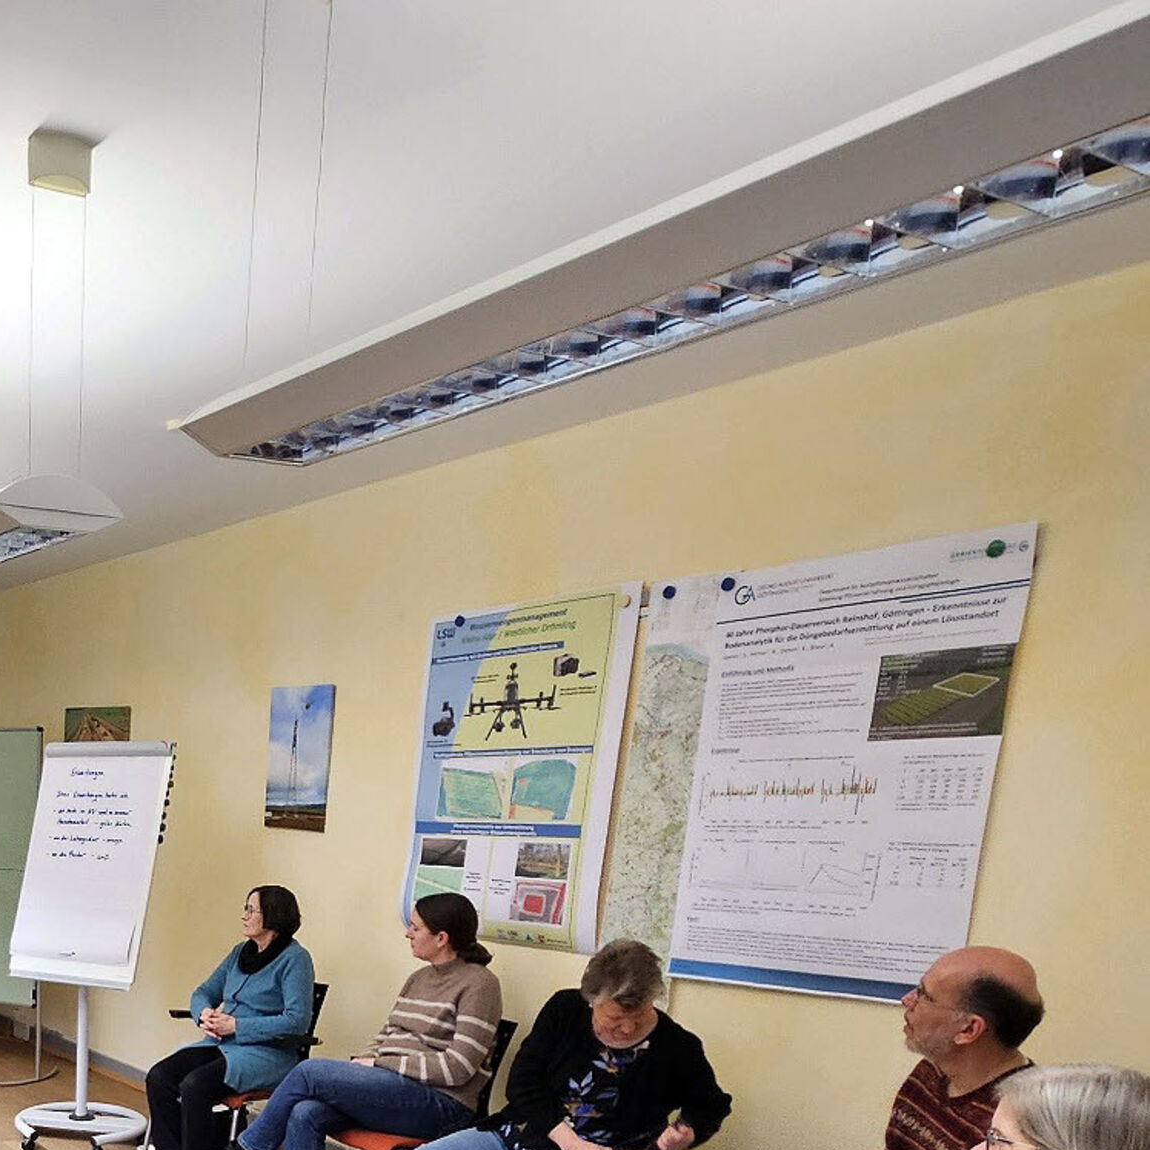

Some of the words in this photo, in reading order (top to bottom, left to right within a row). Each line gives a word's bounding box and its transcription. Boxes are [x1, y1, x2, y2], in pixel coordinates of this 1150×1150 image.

[882, 607, 925, 620] Göttingen
[895, 621, 910, 631] auf
[911, 617, 940, 627] einem
